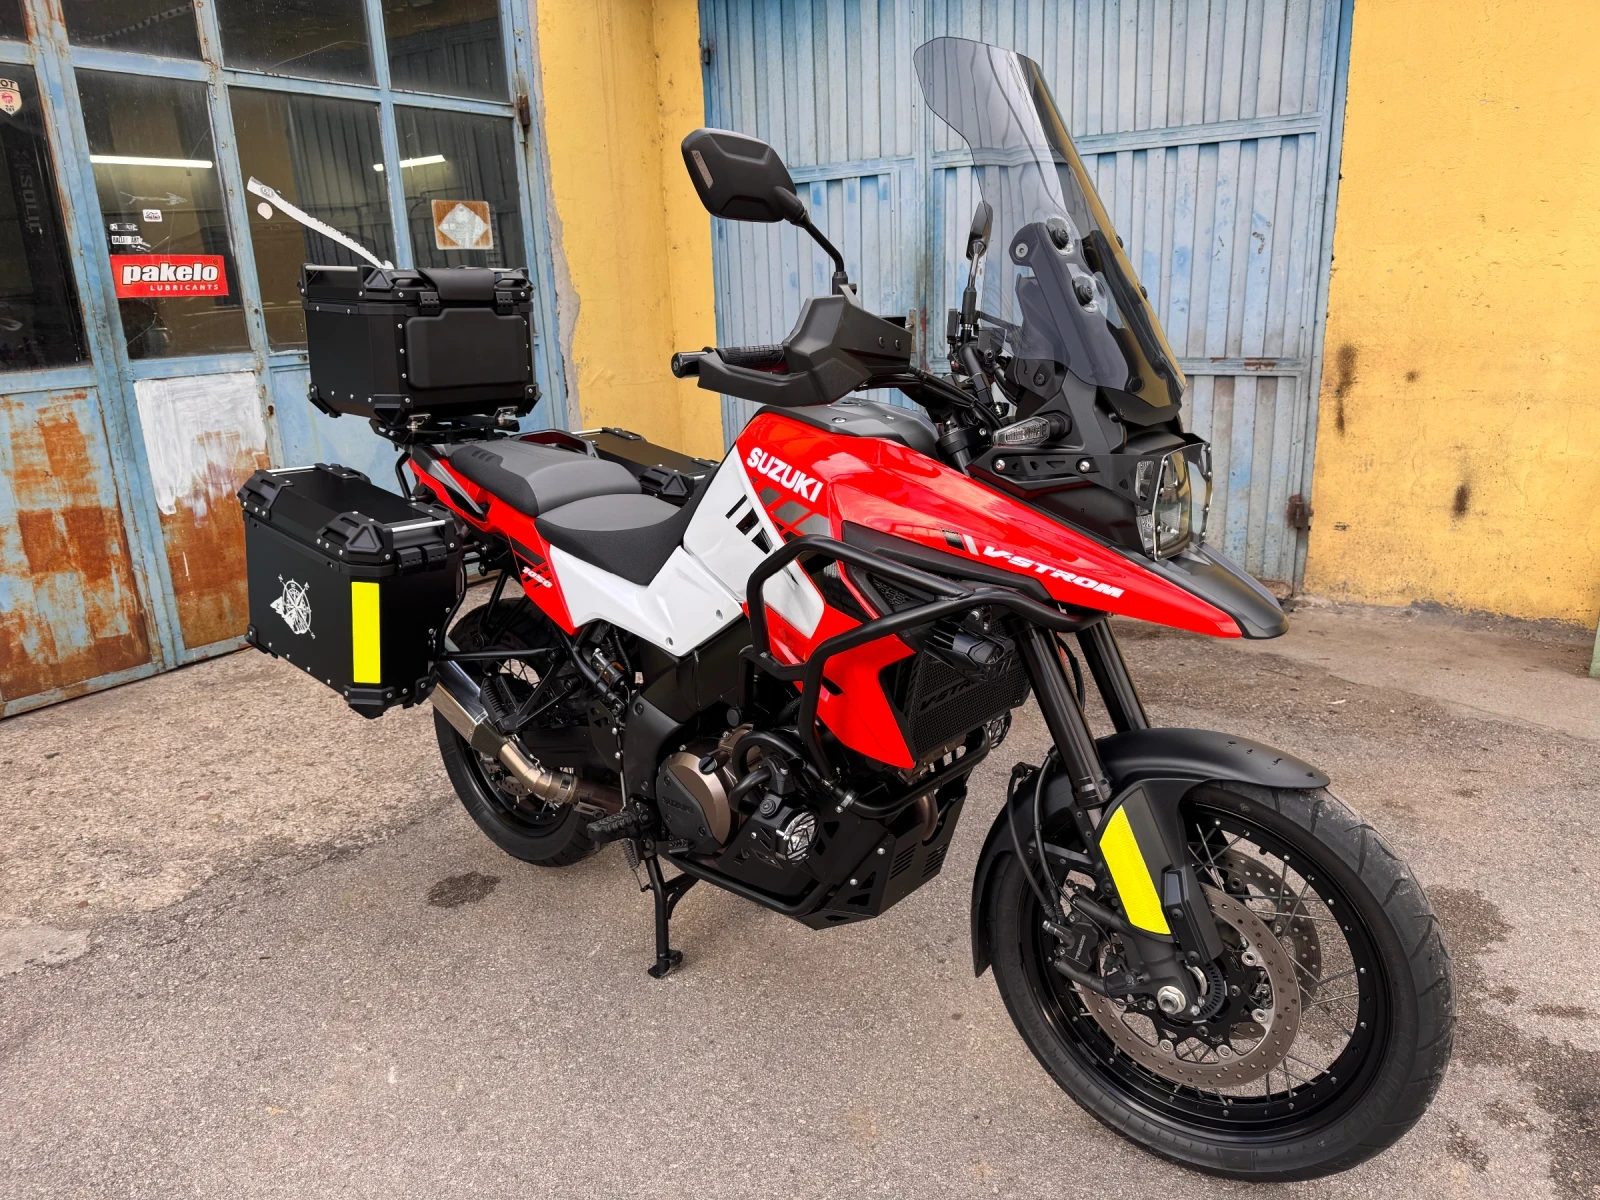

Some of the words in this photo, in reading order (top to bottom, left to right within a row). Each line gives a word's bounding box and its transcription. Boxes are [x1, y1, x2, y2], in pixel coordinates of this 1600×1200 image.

[122, 262, 219, 285] pakelo
[746, 447, 824, 503] SUZUKI
[522, 566, 553, 588] 1050
[983, 545, 1125, 599] V-STROM
